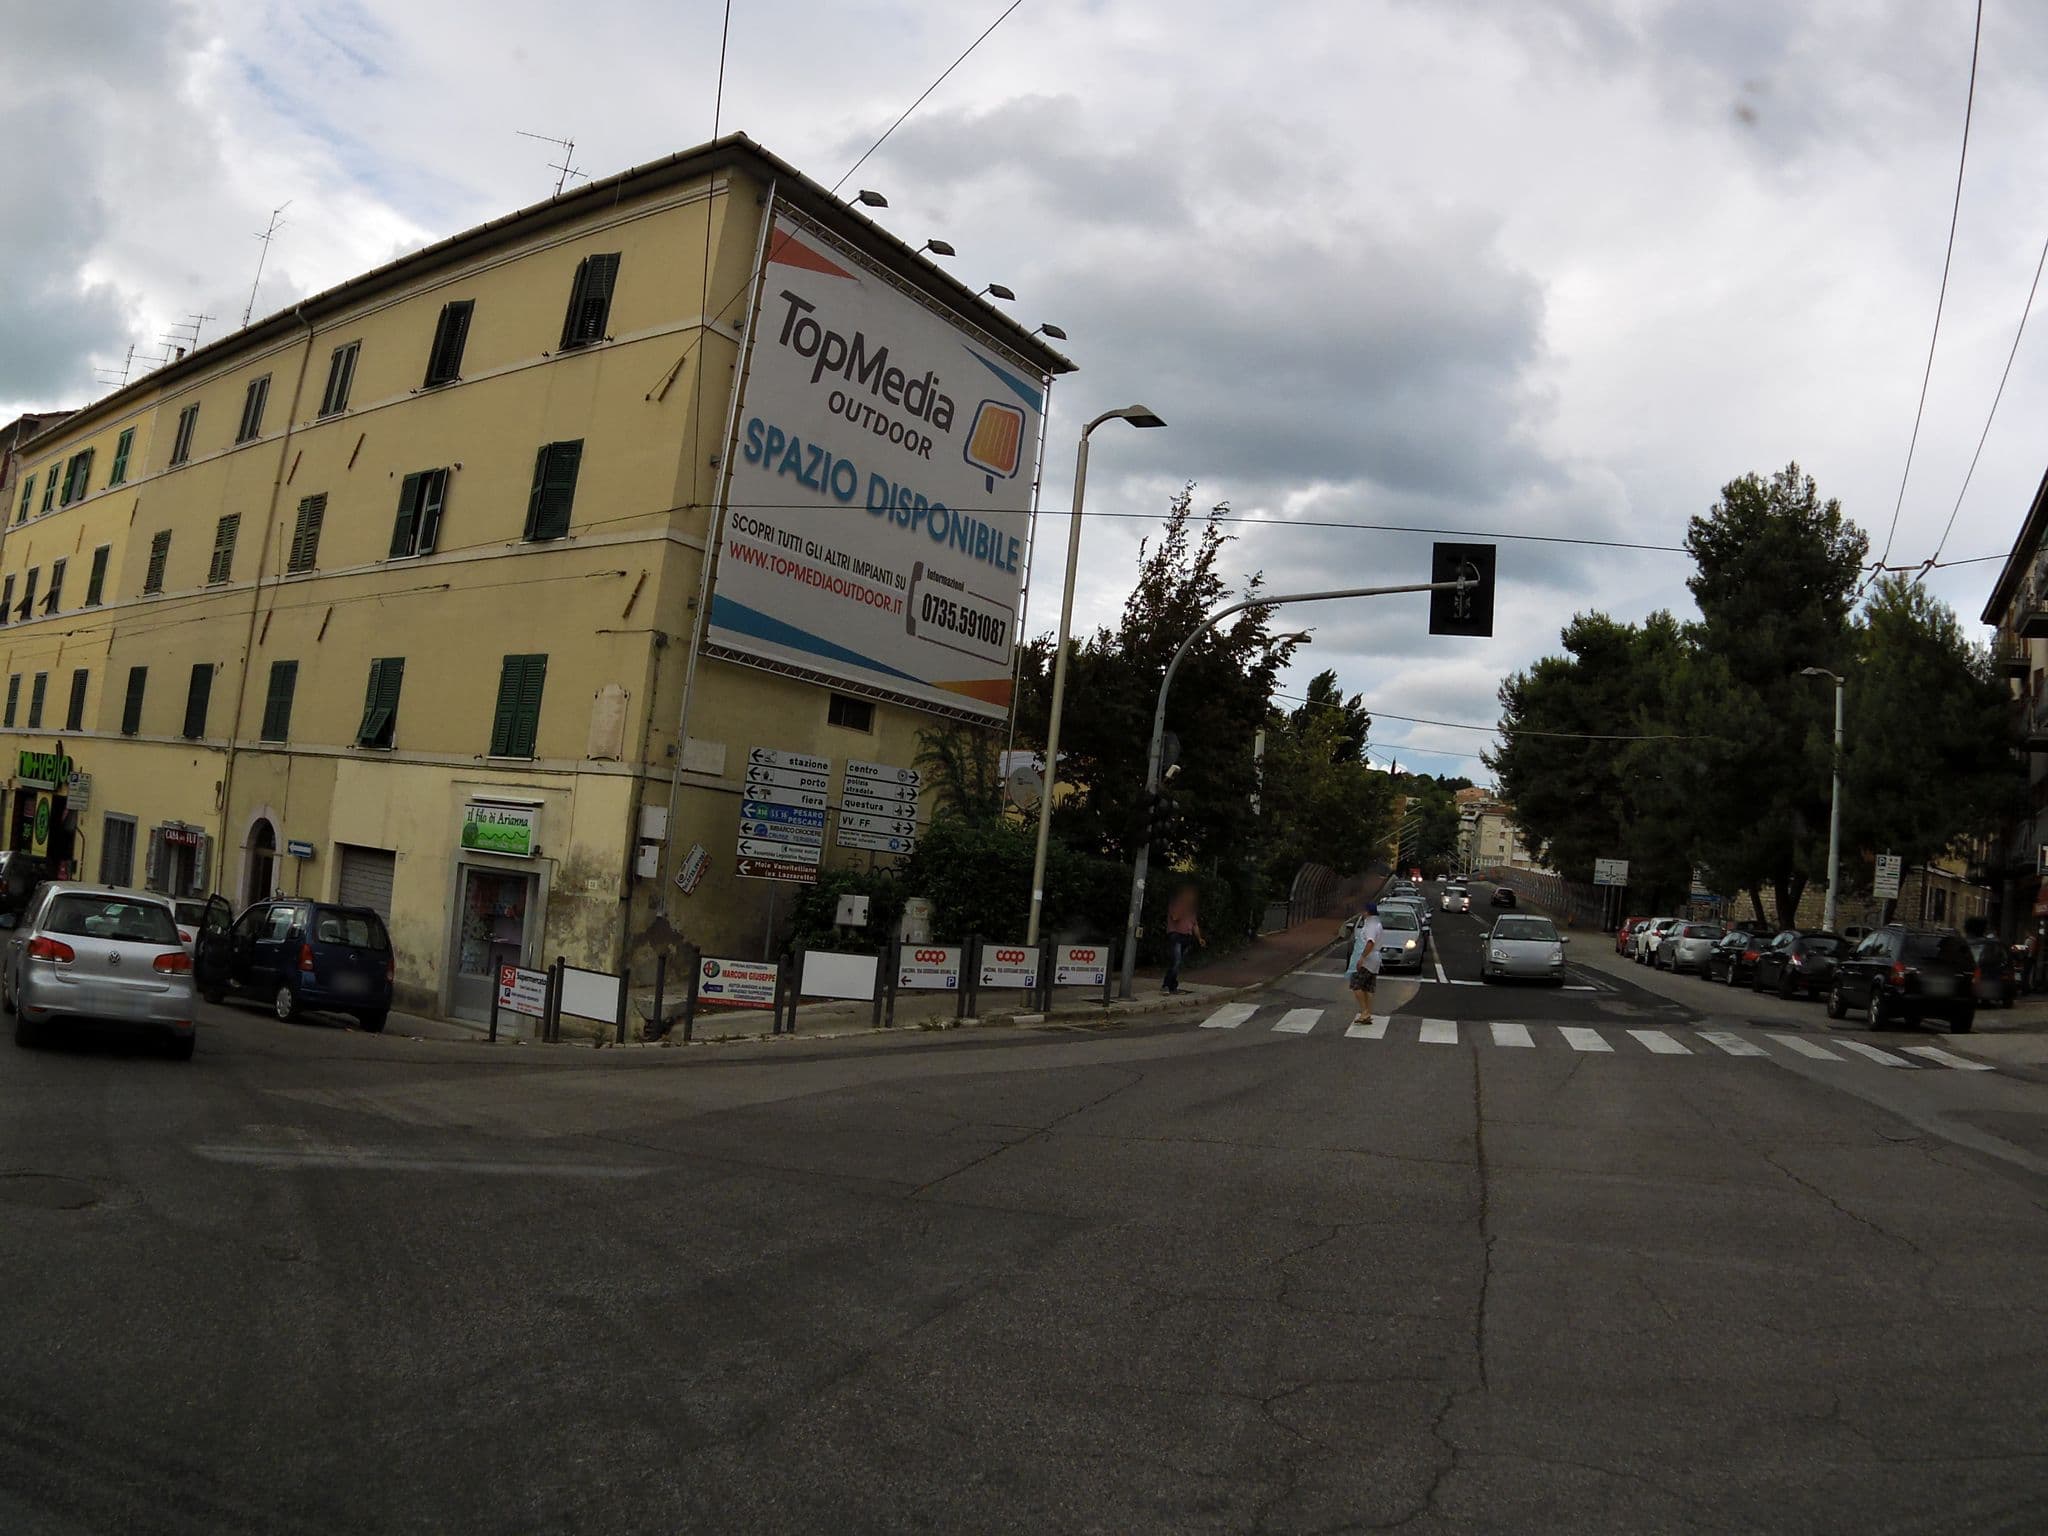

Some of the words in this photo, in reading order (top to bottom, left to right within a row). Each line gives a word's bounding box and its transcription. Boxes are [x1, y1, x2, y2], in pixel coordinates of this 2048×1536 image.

[779, 289, 954, 433] TopMedia
[828, 390, 932, 460] OUTDOOR
[744, 417, 858, 503] SPAZIO
[866, 472, 1021, 574] DISPONIBILE
[731, 513, 775, 543] SCOPRI
[777, 528, 804, 553] TUTTI
[805, 541, 824, 560] GLI
[824, 548, 851, 572] ALTRI
[852, 556, 893, 588] IMPIANTI
[894, 574, 907, 591] SU
[729, 541, 904, 616] WWW.TOPMEDIAOUTDOOR.IT
[921, 592, 1006, 648] 0735.591087
[789, 757, 829, 771] stazione
[849, 764, 879, 776] centro
[800, 777, 826, 789] porto
[801, 795, 824, 806] fiera
[844, 798, 884, 813] questura
[842, 815, 854, 825] VV
[859, 818, 872, 829] FF
[915, 949, 946, 965] coop
[996, 950, 1025, 965] coop
[1070, 949, 1096, 964] coop
